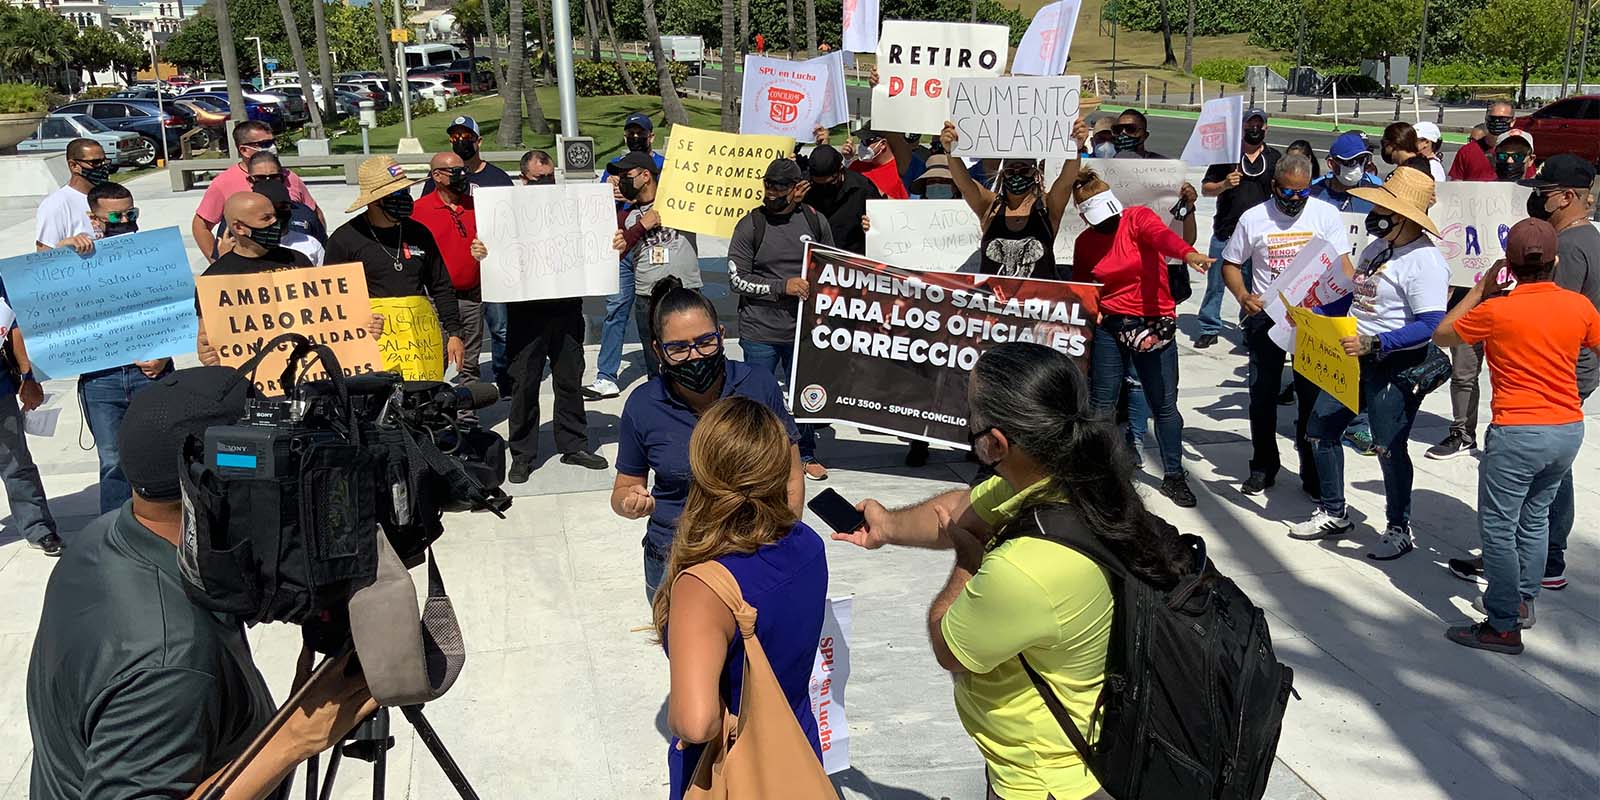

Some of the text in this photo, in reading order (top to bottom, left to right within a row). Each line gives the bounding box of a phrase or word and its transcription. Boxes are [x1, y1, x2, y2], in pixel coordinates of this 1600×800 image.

[889, 44, 997, 69] RETIRO
[759, 66, 776, 76] SPU
[792, 71, 816, 81] Lucha
[889, 76, 950, 98] DIG
[953, 82, 1079, 117] AUMENTO
[957, 117, 1078, 153] SALARIAL
[678, 139, 785, 160] SE ACABARON
[674, 160, 762, 180] LAS PROMES
[685, 181, 763, 200] QUEREMOS
[666, 198, 749, 218] QUE CUMP
[922, 231, 982, 251] AUMEN
[81, 256, 104, 277] que
[98, 272, 142, 287] Salario
[1327, 276, 1348, 297] Luch
[218, 277, 349, 308] AMBIENTE
[817, 263, 1087, 327] AUMENTO SALARIAL
[48, 304, 67, 318] que
[229, 304, 347, 335] LABORAL
[814, 294, 884, 325] PARA
[890, 304, 942, 332] LOS
[268, 328, 367, 352] GALDAD
[811, 324, 985, 372] CORRECCIO
[836, 395, 856, 406] ACU
[857, 398, 881, 411] 3500
[889, 404, 920, 419] SPUPR
[922, 410, 967, 427] CONCILIO
[818, 636, 834, 752] SPU en Lucha
